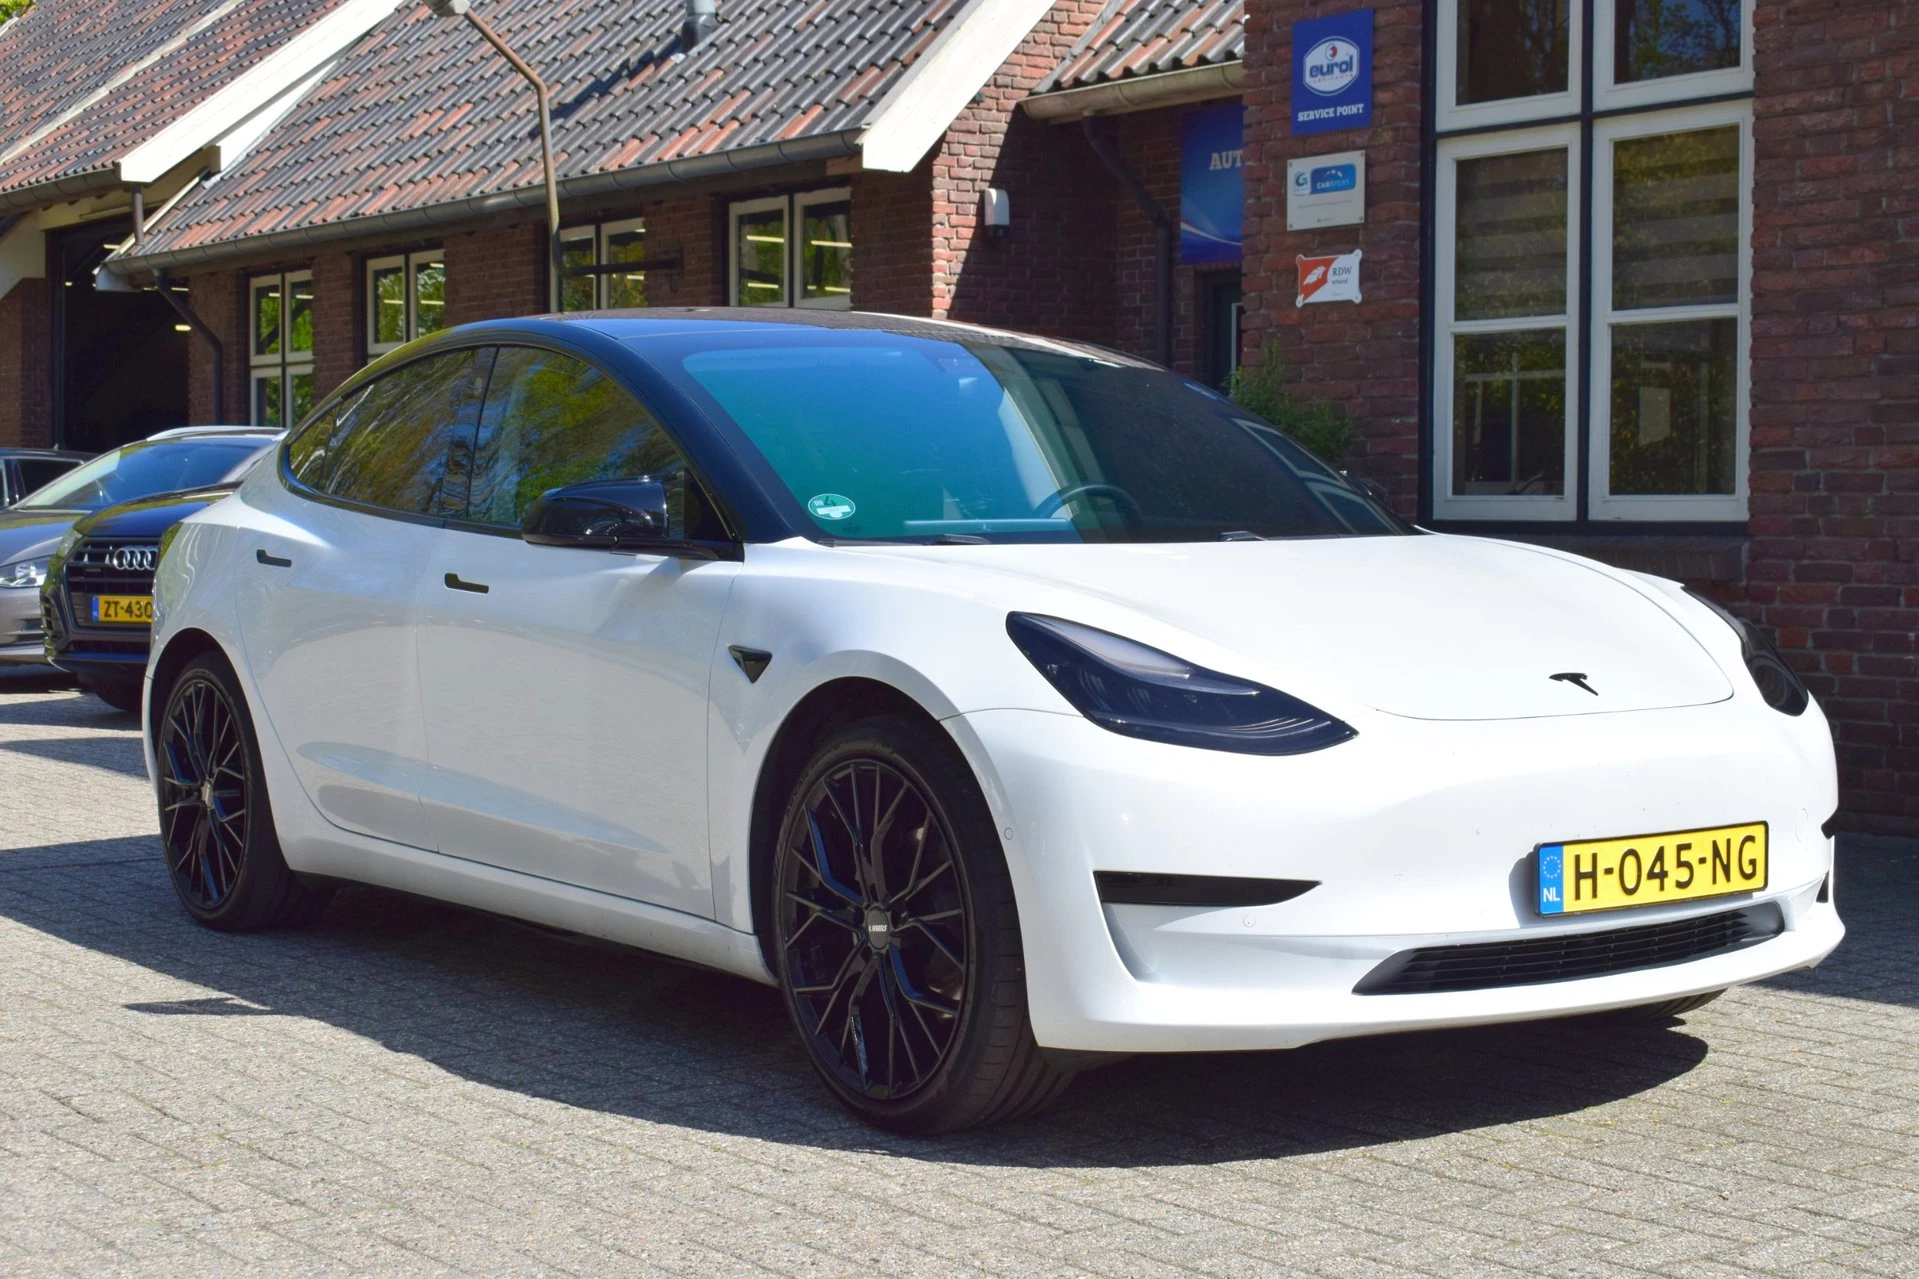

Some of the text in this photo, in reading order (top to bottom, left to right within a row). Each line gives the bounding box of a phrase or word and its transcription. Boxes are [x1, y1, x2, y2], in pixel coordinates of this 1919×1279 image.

[1309, 54, 1354, 78] eurol
[1298, 104, 1364, 121] SERVICE POINT
[1332, 266, 1352, 276] RDW
[1574, 834, 1757, 901] H-045-NG
[1543, 887, 1561, 902] NL
